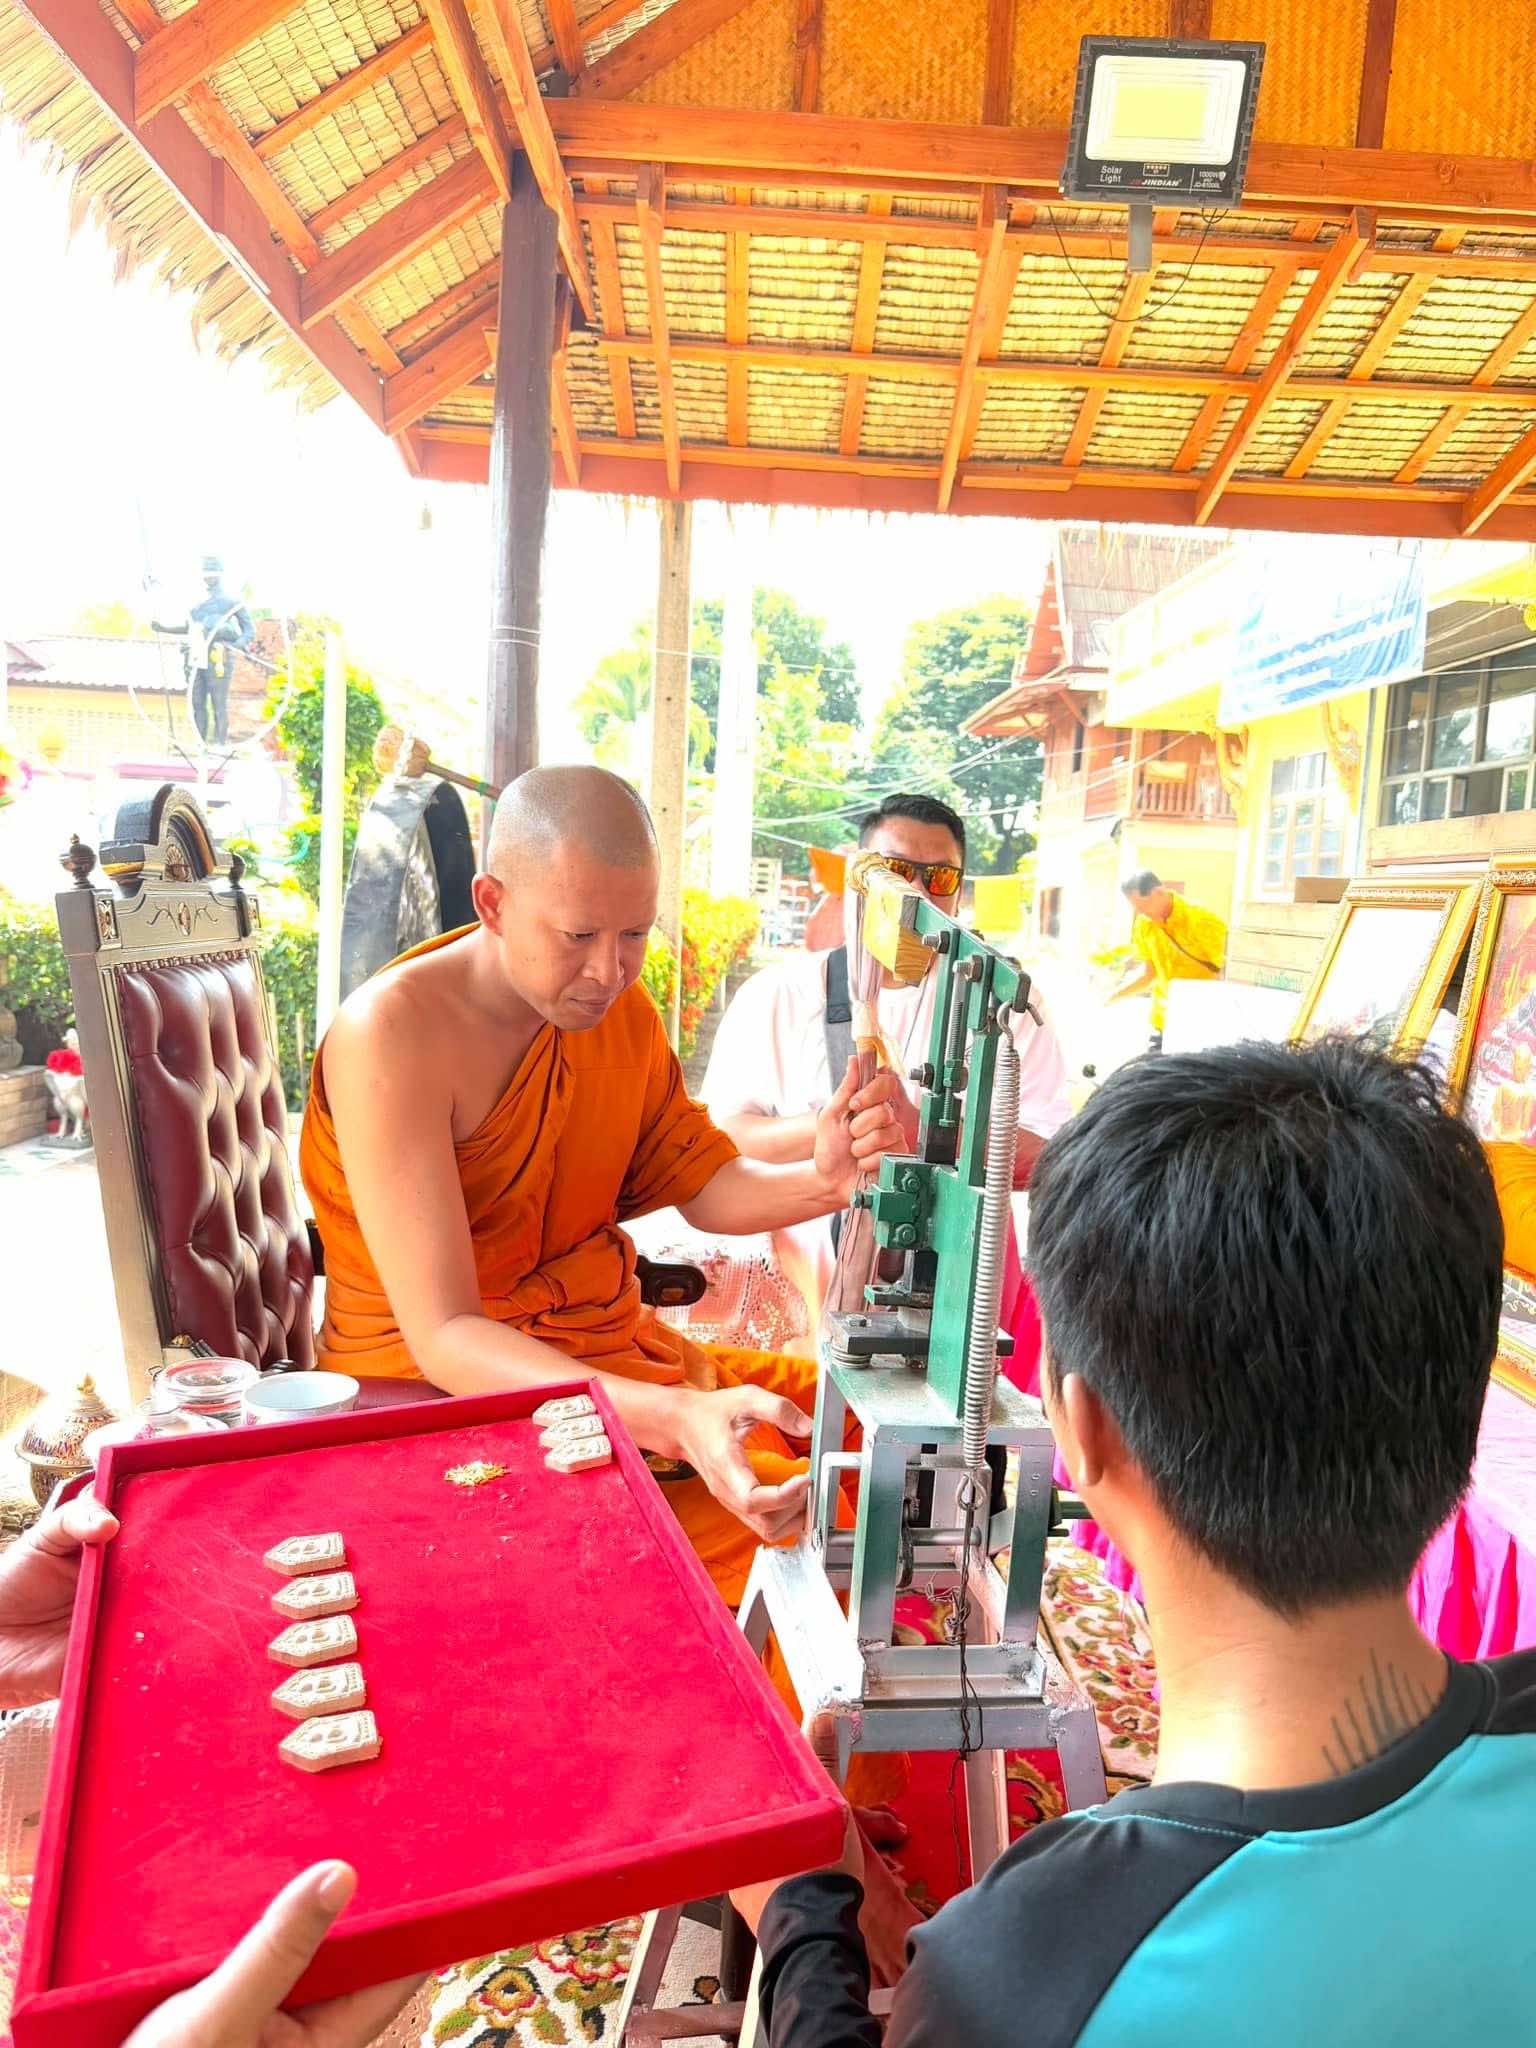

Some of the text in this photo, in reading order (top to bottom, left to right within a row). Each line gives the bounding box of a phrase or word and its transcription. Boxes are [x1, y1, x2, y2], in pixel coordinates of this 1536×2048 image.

[1101, 165, 1122, 174] Solar
[1100, 174, 1121, 184] Light
[1141, 179, 1179, 187] JINDIAN
